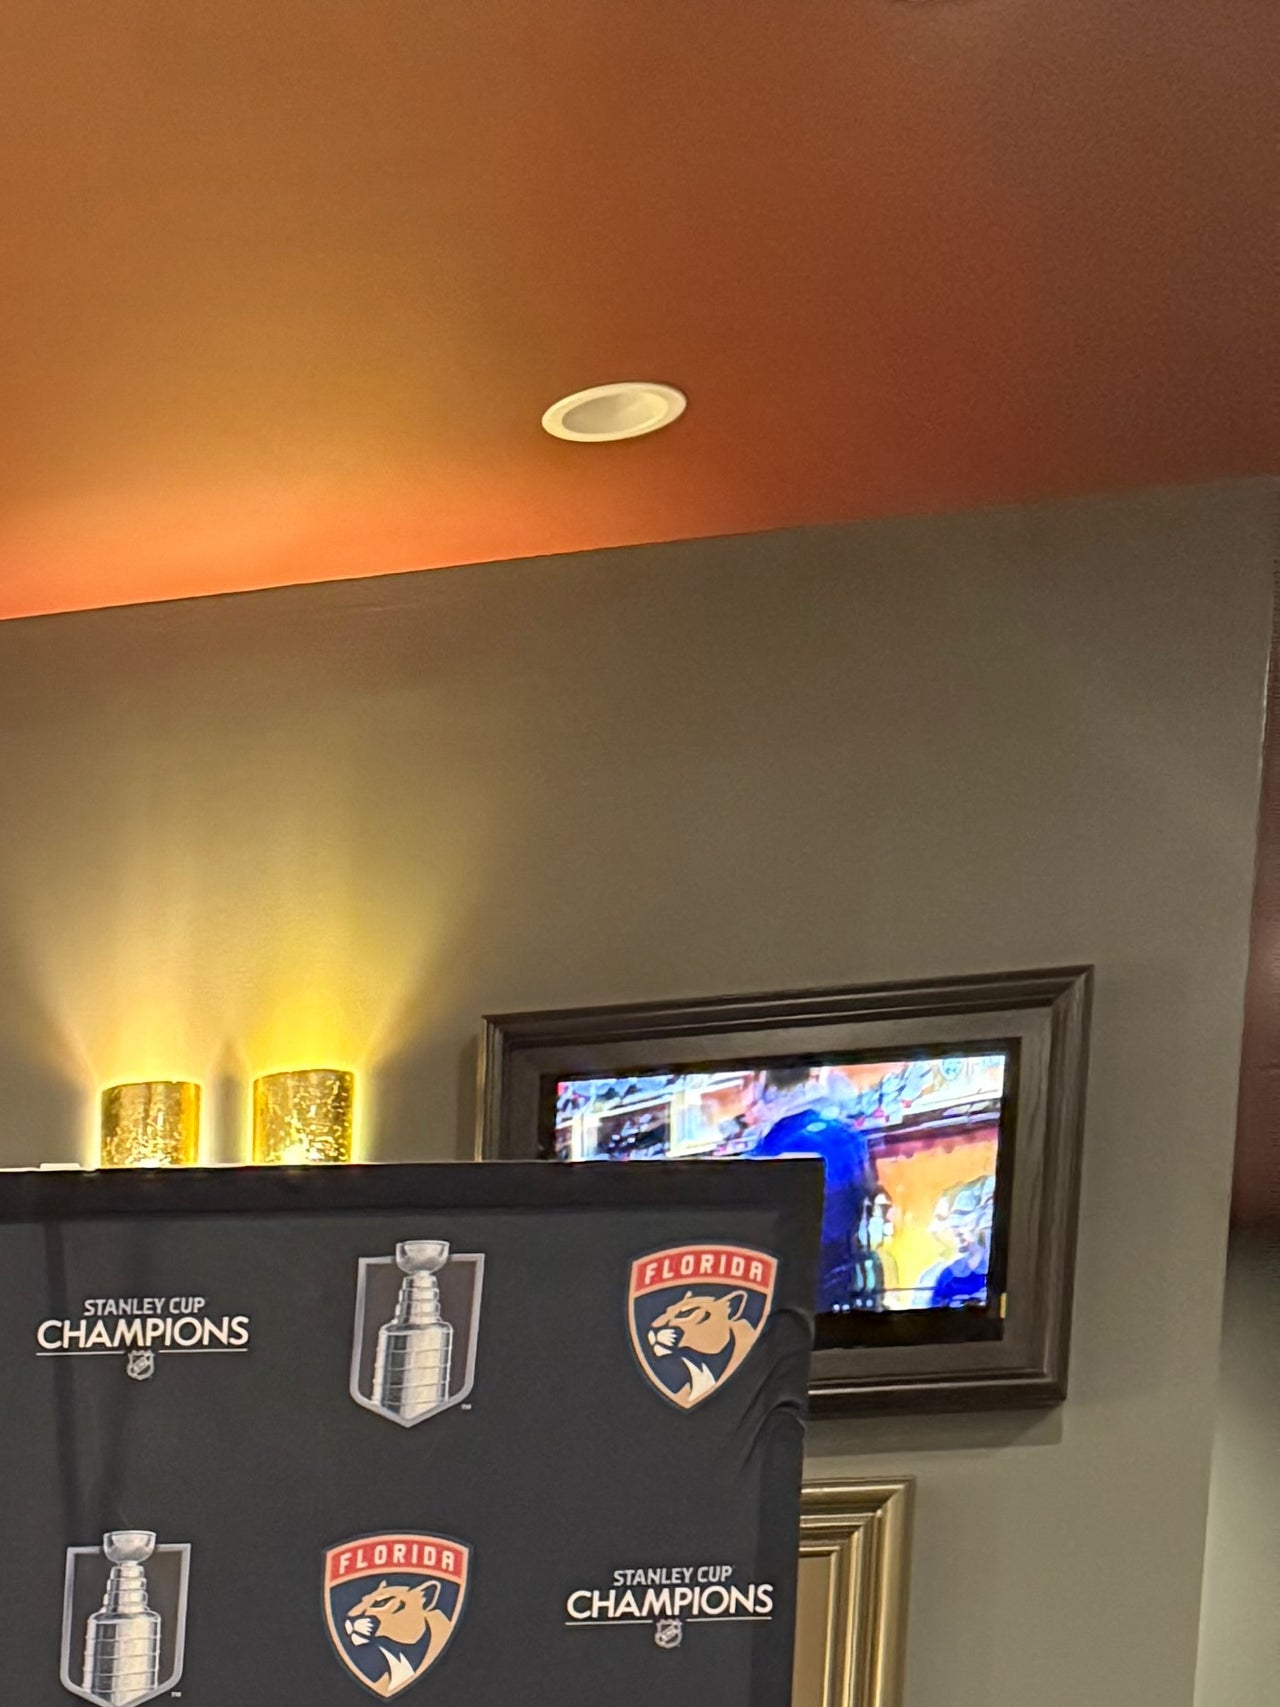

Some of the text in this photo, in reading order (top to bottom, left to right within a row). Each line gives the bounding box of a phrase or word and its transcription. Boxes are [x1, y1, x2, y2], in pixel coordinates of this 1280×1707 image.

[645, 1254, 762, 1284] FLORIDA
[84, 1297, 205, 1316] STANLEY CUP
[38, 1316, 249, 1349] CHAMPIONS
[340, 1544, 454, 1574] FLORIDA
[614, 1566, 732, 1586] STANLEY CUP
[567, 1584, 773, 1618] CHAMPIONS
